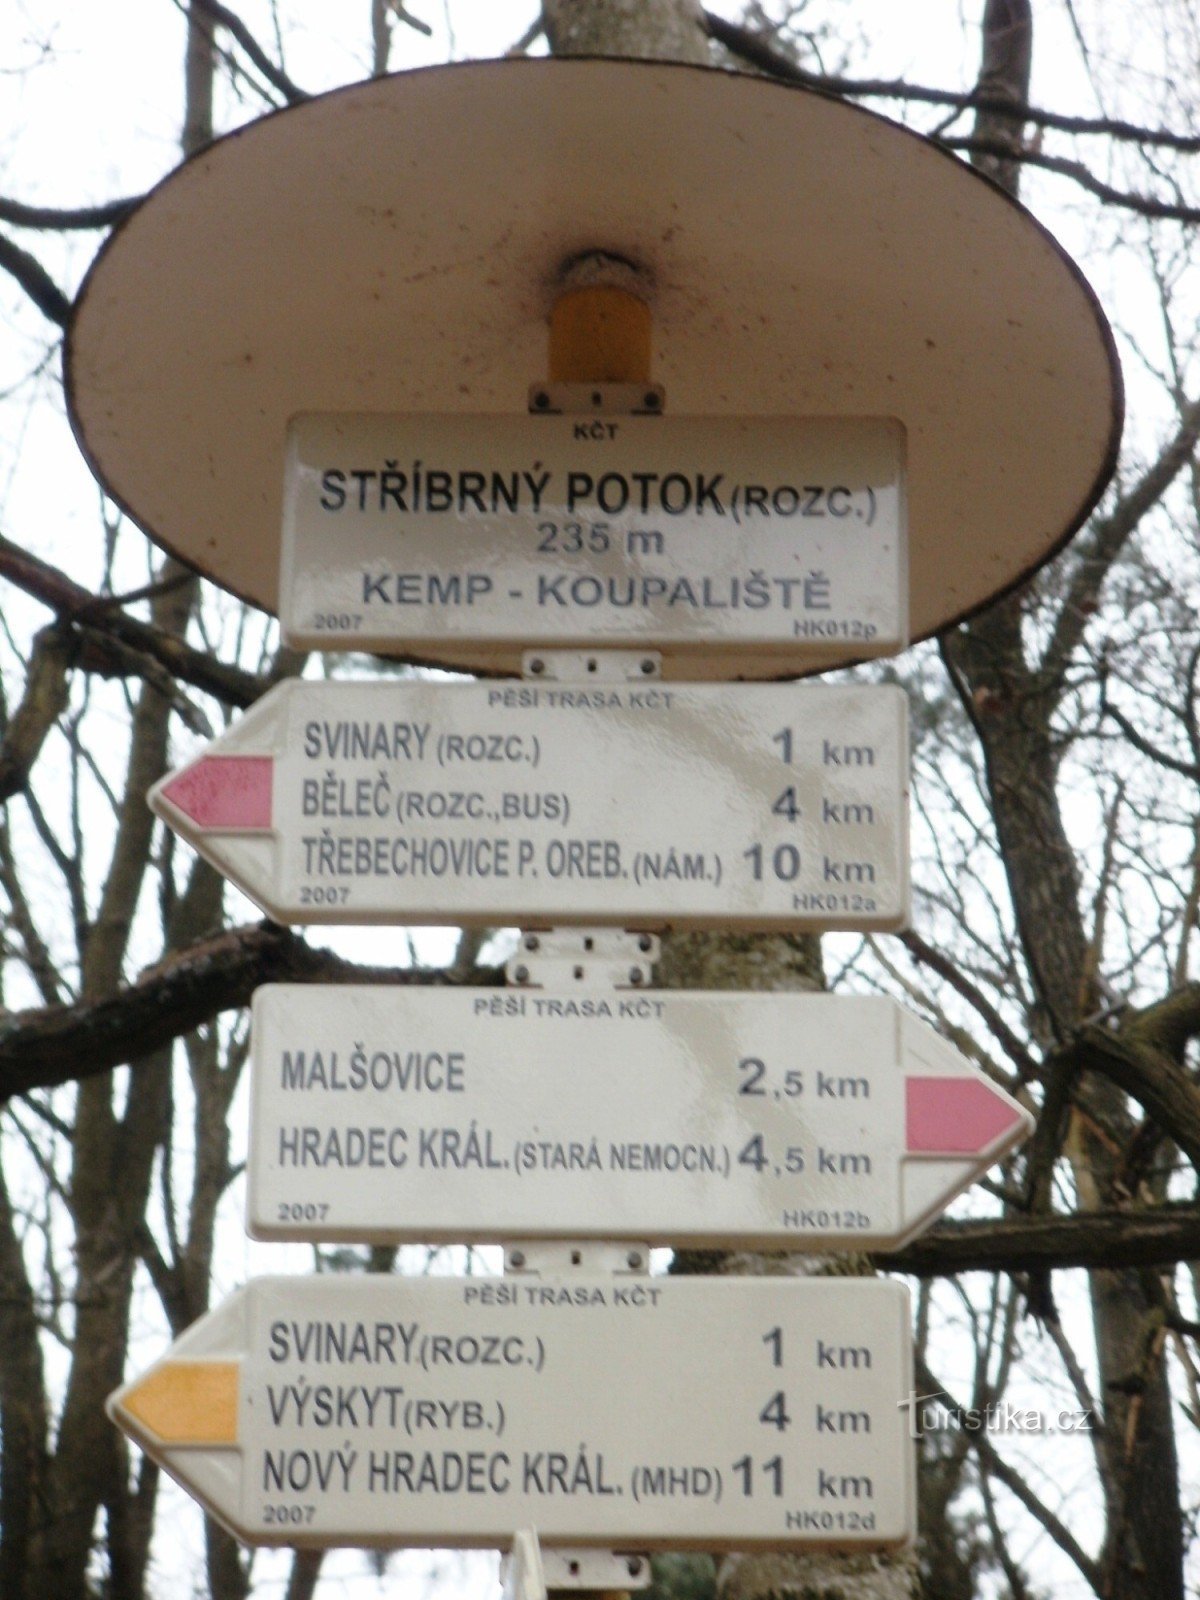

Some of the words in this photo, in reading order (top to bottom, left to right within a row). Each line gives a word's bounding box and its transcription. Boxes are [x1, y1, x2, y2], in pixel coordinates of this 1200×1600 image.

[574, 421, 619, 440] KČT
[319, 459, 550, 513] STŘÍBRNÝ
[536, 521, 610, 554] 235
[627, 529, 665, 555] m
[362, 573, 493, 605] KEMP
[508, 589, 522, 598] -
[537, 569, 832, 610] KOUPALIŠTĚ
[314, 613, 363, 630] 2007
[793, 619, 877, 640] HK012p
[488, 688, 539, 708] PĚŠÍ
[547, 690, 622, 709] TRASA
[630, 690, 673, 710] KČT
[304, 721, 430, 761] SVINARY
[772, 727, 793, 764] 1
[822, 739, 875, 766] km
[302, 769, 391, 818] BĚLEČ
[771, 786, 801, 823] 4
[822, 797, 875, 824] km
[302, 828, 510, 877] TŘEBECHOVICE
[518, 840, 538, 878] P.
[743, 843, 800, 882] 10
[823, 856, 876, 883] km
[300, 887, 350, 904] 2007
[792, 893, 877, 912] HK012a
[473, 995, 526, 1017] PĚŠÍ
[533, 998, 612, 1018] TRASA
[619, 997, 665, 1019] KČT
[281, 1041, 465, 1092] MALŠOVICE
[738, 1057, 804, 1100] 2,5
[816, 1071, 871, 1098] km
[278, 1126, 408, 1169] HRADEC
[610, 1142, 730, 1179] NEMOCN.)
[738, 1133, 805, 1178] 4,5
[818, 1147, 872, 1175] km
[278, 1202, 330, 1221] 2007
[783, 1209, 871, 1230] HK012b
[464, 1284, 517, 1304] PĚŠÍ
[525, 1287, 606, 1306] TRASA
[613, 1285, 661, 1307] KČT
[269, 1321, 419, 1363] SVINARY
[762, 1326, 783, 1368] 1
[817, 1340, 872, 1369] km
[759, 1390, 792, 1432] 4
[816, 1404, 871, 1433] km
[263, 1440, 357, 1493] NOVÝ
[369, 1451, 510, 1494] HRADEC
[732, 1454, 784, 1497] 11
[818, 1469, 873, 1498] km
[263, 1505, 316, 1524] 2007
[786, 1510, 876, 1530] HK012d
